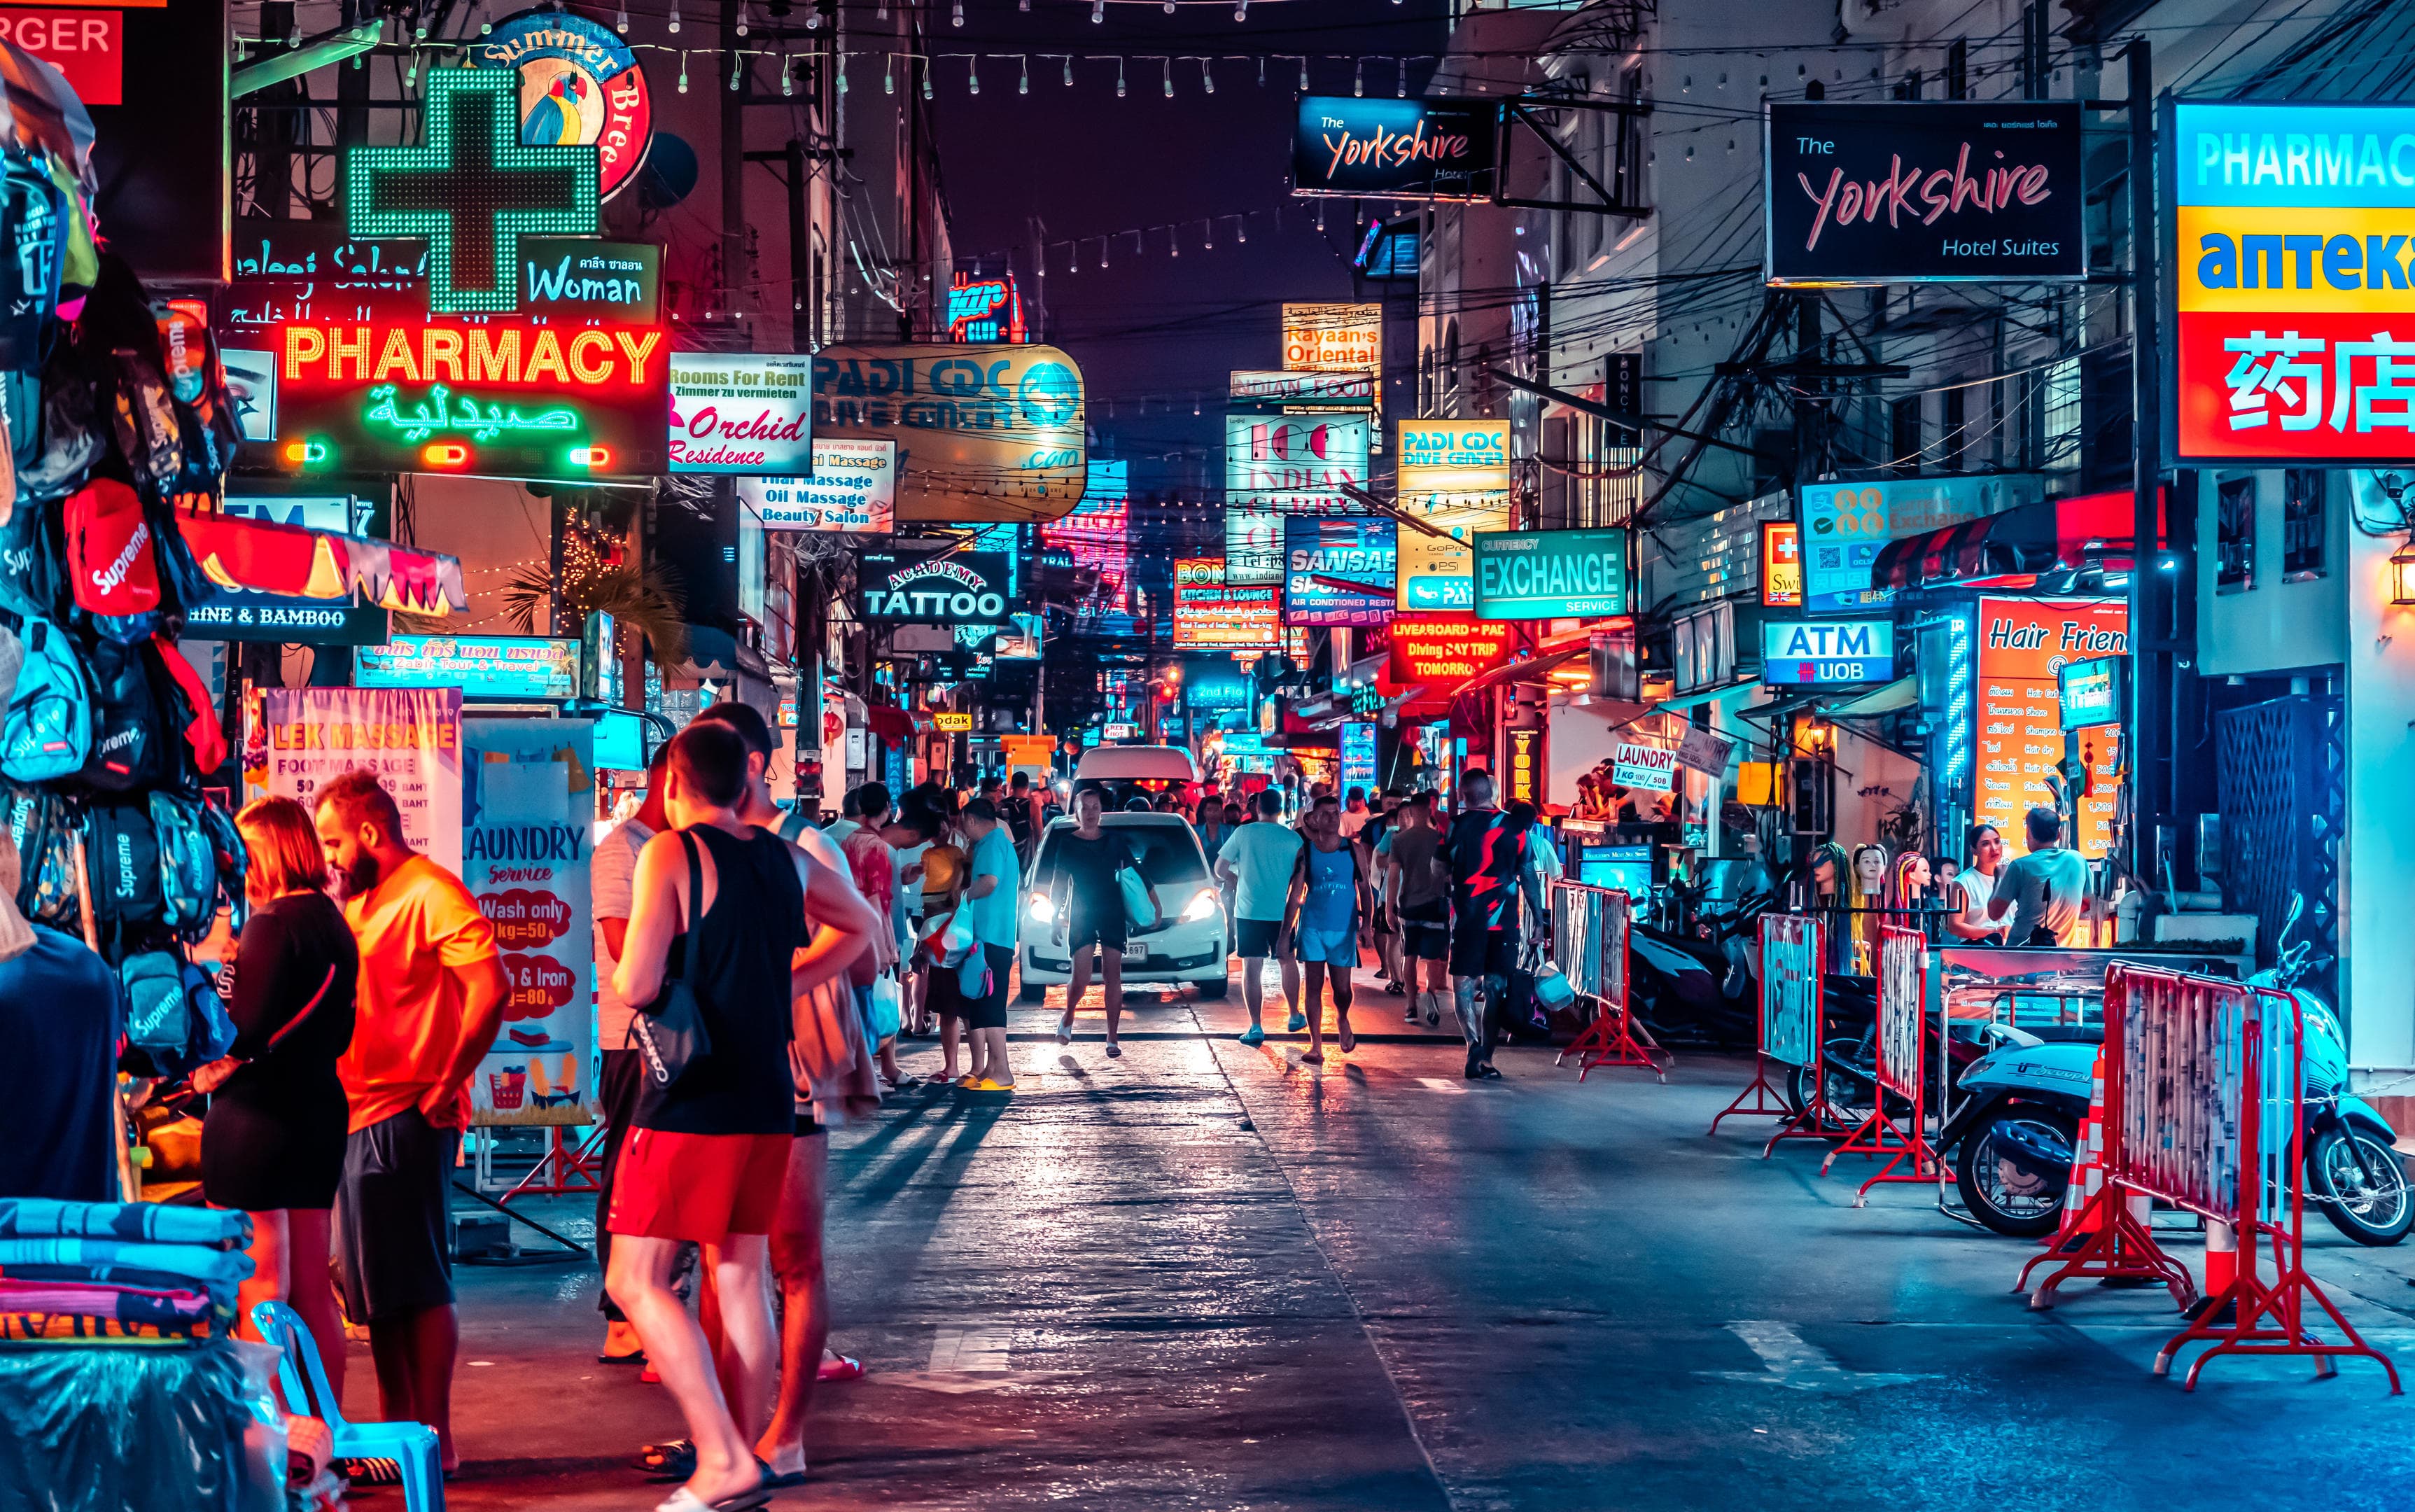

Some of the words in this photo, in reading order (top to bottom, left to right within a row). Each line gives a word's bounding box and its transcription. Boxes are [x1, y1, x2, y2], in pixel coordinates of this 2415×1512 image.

[484, 29, 617, 74] Summer
[600, 87, 640, 174] Bree
[1322, 116, 1344, 129] The
[1322, 119, 1469, 179] Yorkshire
[1797, 136, 1835, 155] The
[1798, 141, 2052, 252] Yorkshire
[1942, 239, 1996, 256] Hotel
[2002, 237, 2059, 256] Suites
[528, 255, 641, 304] Woman
[1287, 326, 1377, 345] Rayaan's
[285, 327, 662, 384] PHARMACY
[1287, 344, 1375, 363] Oriental
[670, 369, 729, 385] Rooms
[734, 370, 760, 385] For
[765, 371, 805, 386] Rent
[815, 358, 913, 396] PADI
[930, 359, 1010, 398] CDC
[2224, 330, 2415, 434] 药店
[676, 386, 720, 397] Zimmer
[721, 388, 734, 397] zu
[737, 389, 797, 398] vermieten
[1313, 379, 1372, 398] FOOD
[368, 384, 578, 440] صيدلية
[689, 407, 806, 441] Orchid
[1404, 432, 1454, 450] PADI
[1462, 432, 1503, 450] CDC
[669, 440, 764, 465] Residence
[1021, 449, 1079, 470] .com
[1404, 452, 1441, 465] DIVE
[829, 454, 887, 470] Massage
[804, 473, 873, 489] Massage
[1249, 469, 1357, 489] INDIAN
[766, 490, 788, 503] Oil
[797, 491, 867, 507] Massage
[762, 509, 818, 524] Beauty
[825, 510, 869, 524] Salon
[1427, 544, 1467, 552] GoPro
[1481, 538, 1539, 552] CURRENCY
[92, 522, 148, 595] Supreme
[888, 561, 987, 592] ACADEMY
[1481, 553, 1618, 596] EXCHANGE
[865, 591, 1004, 616] TATTOO
[1180, 589, 1222, 601] KITCHEN
[1224, 589, 1232, 601] &
[1233, 589, 1273, 601] LOUNGE
[1565, 600, 1618, 612] SERVICE
[238, 608, 253, 624] &
[260, 608, 345, 626] BAMBOO
[1786, 626, 1870, 655] ATM
[1989, 618, 2050, 650] Hair
[2060, 621, 2127, 652] Frien
[1408, 643, 1443, 659] Diving
[1471, 643, 1498, 657] TRIP
[395, 657, 434, 669] Zabir
[440, 658, 472, 671] Tour
[478, 659, 489, 671] &
[494, 659, 539, 672] Travel
[1415, 662, 1484, 676] TOMORRO
[1820, 662, 1864, 680] UOB
[1199, 686, 1220, 696] 2nd
[2026, 689, 2043, 699] Hair
[2045, 689, 2059, 699] Cut
[2026, 706, 2047, 717] Shave
[274, 722, 325, 750] LEK
[330, 722, 455, 750] MASSAGE
[2025, 726, 2057, 736] Shampoo
[1618, 746, 1674, 769] LAUNDRY
[2025, 746, 2040, 755] Hair
[2042, 746, 2054, 756] dry
[277, 759, 326, 774] FOOT
[1616, 767, 1620, 777] 1
[2043, 764, 2057, 774] Spa
[296, 779, 314, 793] 50
[402, 783, 428, 792] BAHT
[402, 799, 428, 808] BAHT
[2088, 802, 2112, 812] 1,500
[463, 826, 585, 861] AUNDRY
[117, 833, 136, 899] Supreme
[489, 862, 554, 884] Service
[478, 899, 525, 918] Wash
[531, 899, 564, 923] only
[1126, 945, 1144, 954] 697
[520, 967, 532, 987] &
[537, 967, 568, 986] Iron
[134, 986, 183, 1037] Supreme
